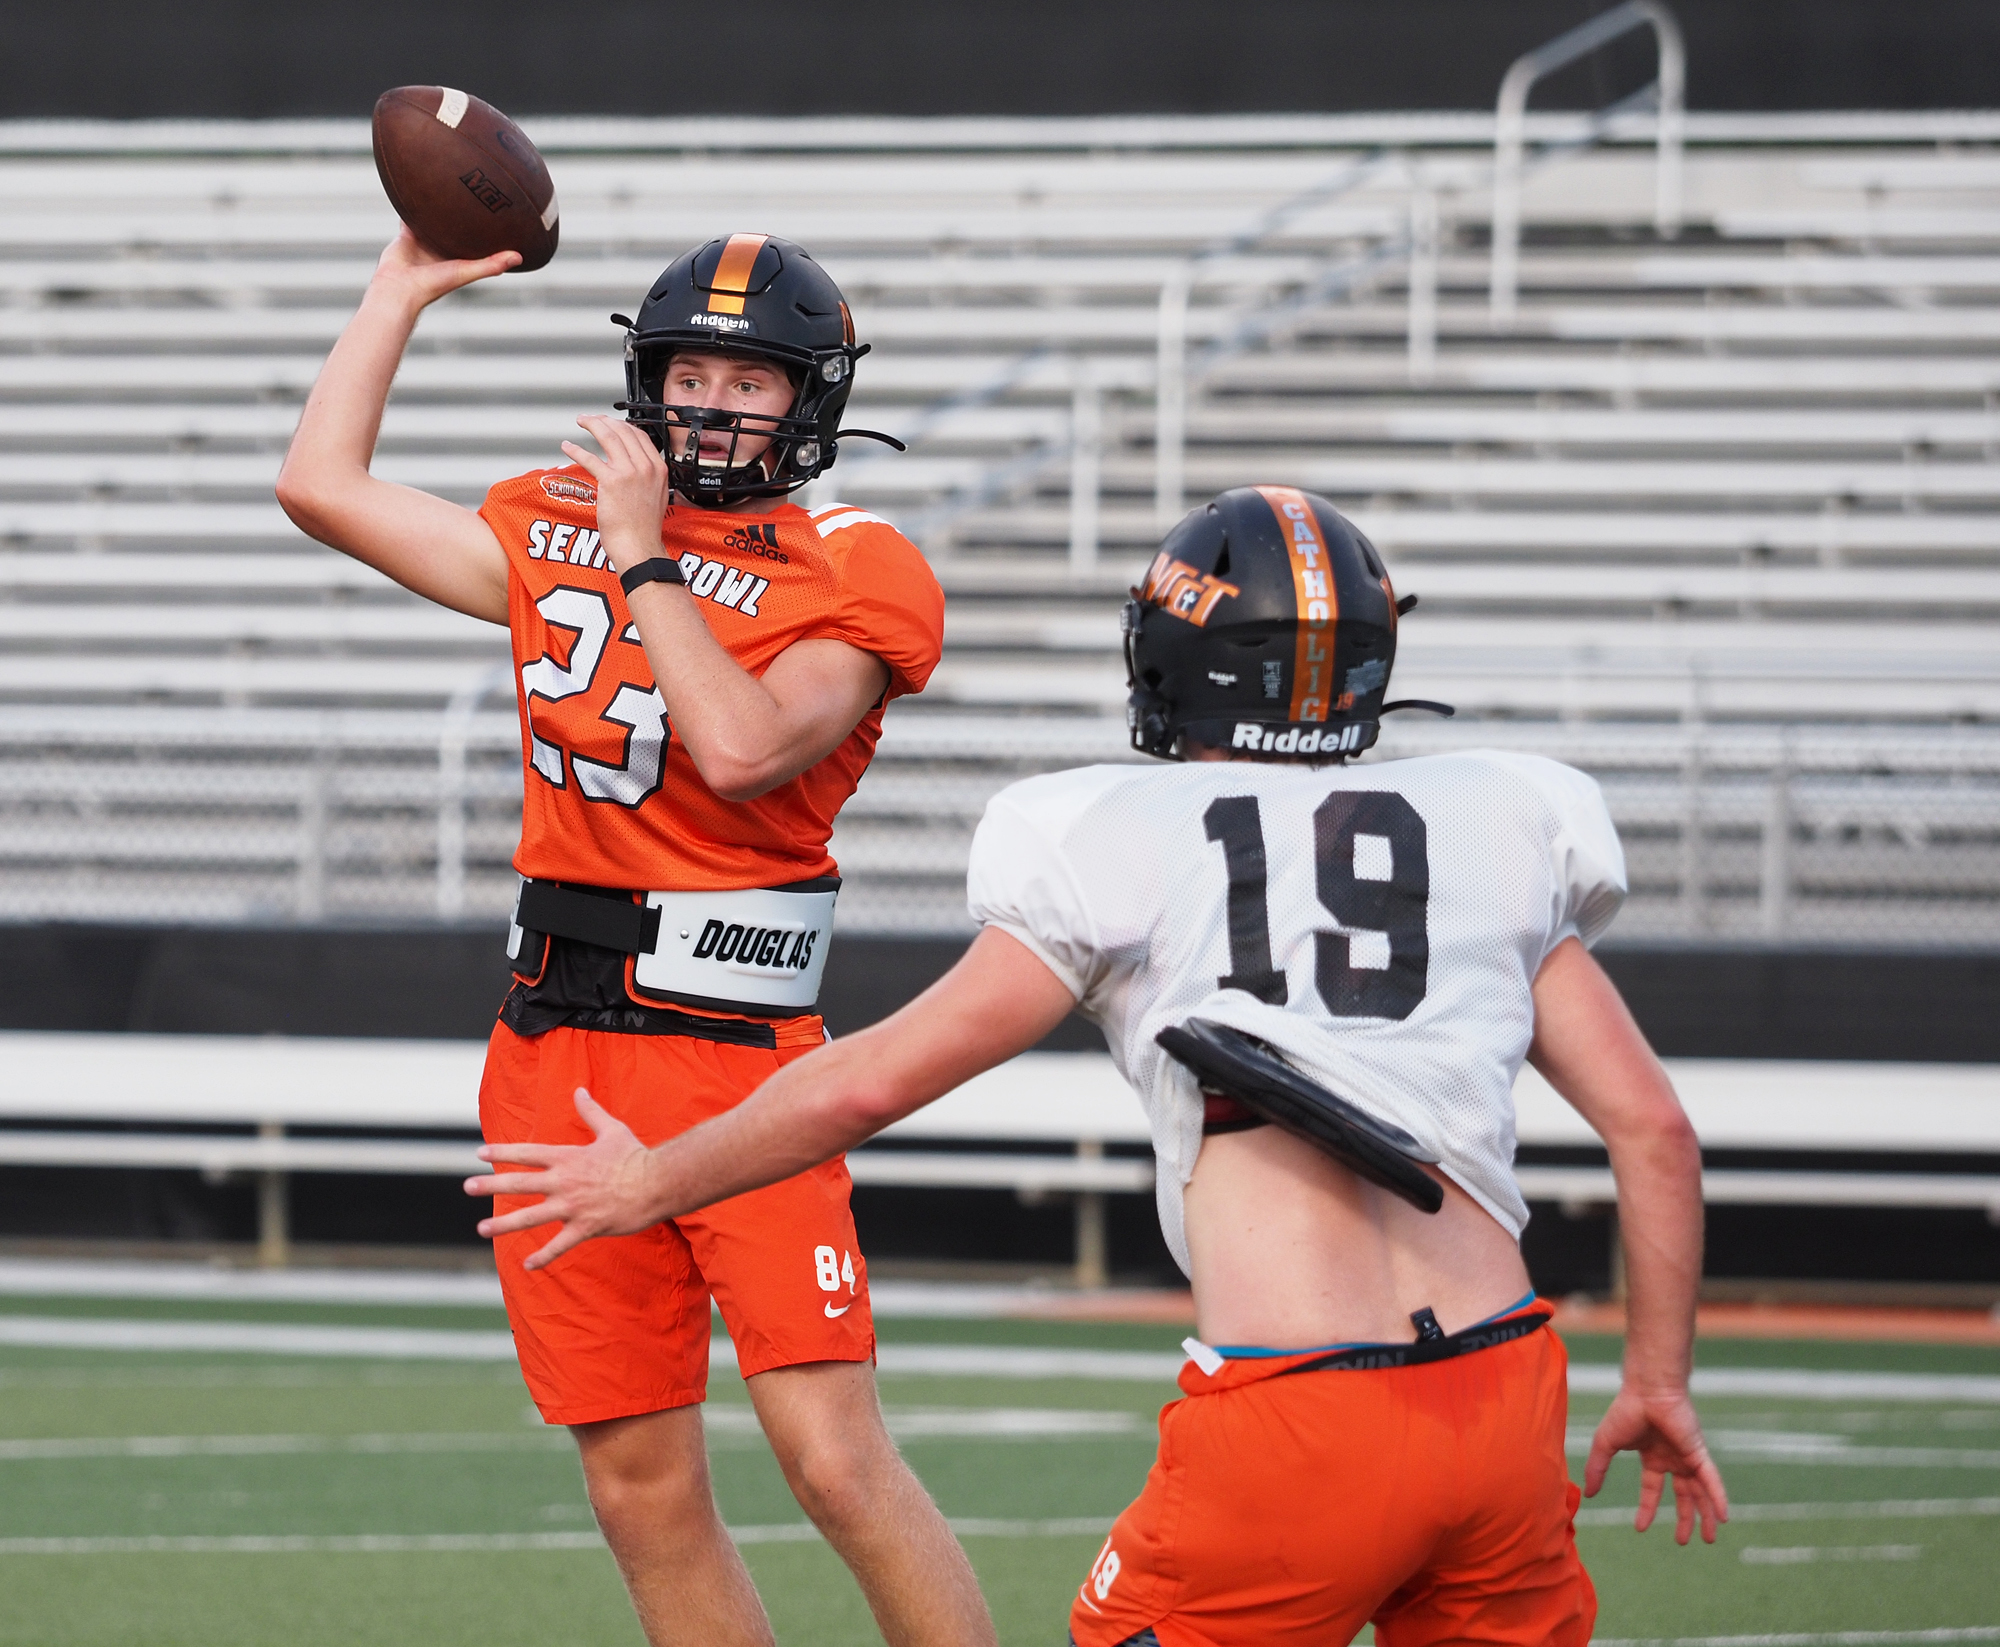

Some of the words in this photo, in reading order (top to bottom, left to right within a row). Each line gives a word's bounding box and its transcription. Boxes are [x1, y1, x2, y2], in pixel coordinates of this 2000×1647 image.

[690, 313, 750, 330] Riddell
[699, 477, 722, 486] ddell
[526, 519, 617, 573] SENI
[678, 550, 771, 618] BOWL
[723, 533, 789, 565] adidas
[1282, 503, 1329, 722] CATHOLIC
[521, 583, 672, 811] 23
[1231, 722, 1361, 754] Riddell
[1202, 790, 1430, 1022] 19
[692, 918, 817, 970] DOUGLAS
[814, 1245, 856, 1296] 84
[1319, 1350, 1406, 1371] NIK
[1091, 1535, 1121, 1600] 19
